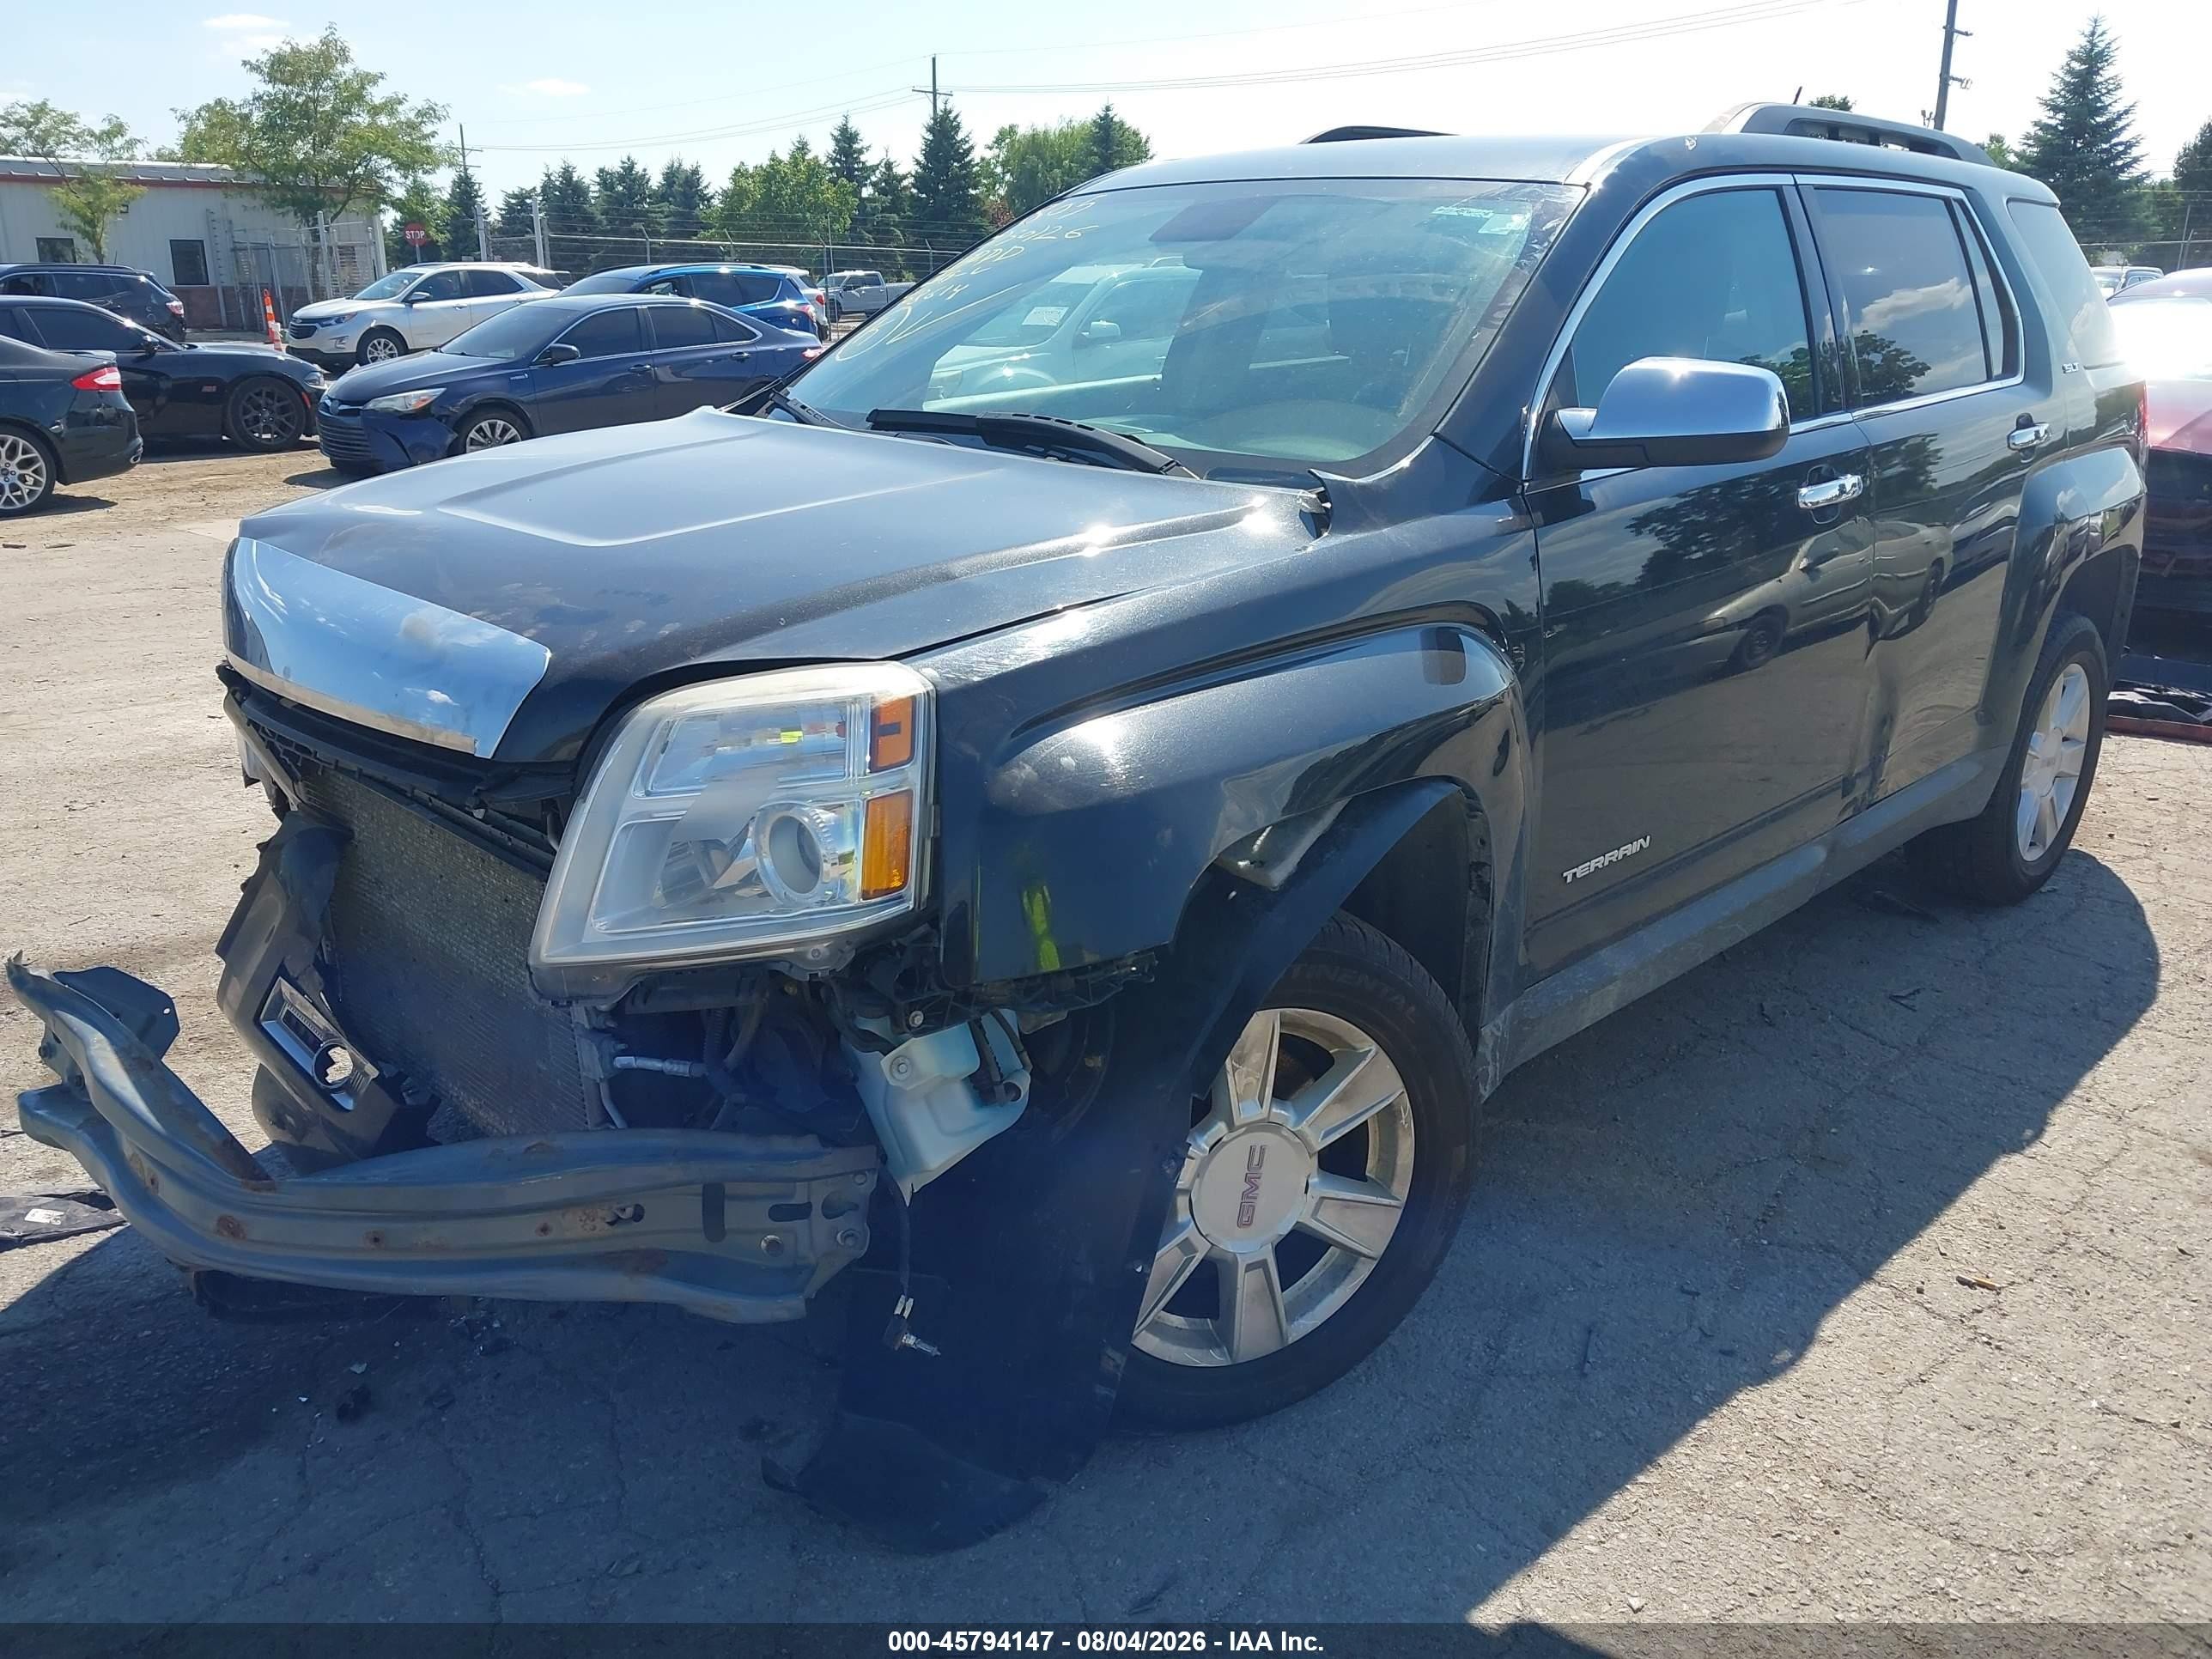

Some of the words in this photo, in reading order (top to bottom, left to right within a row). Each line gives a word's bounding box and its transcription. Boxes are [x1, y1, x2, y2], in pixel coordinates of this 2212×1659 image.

[405, 230, 425, 240] STOP
[1562, 836, 1650, 884] TERRAIN
[1237, 1145, 1267, 1228] GMC
